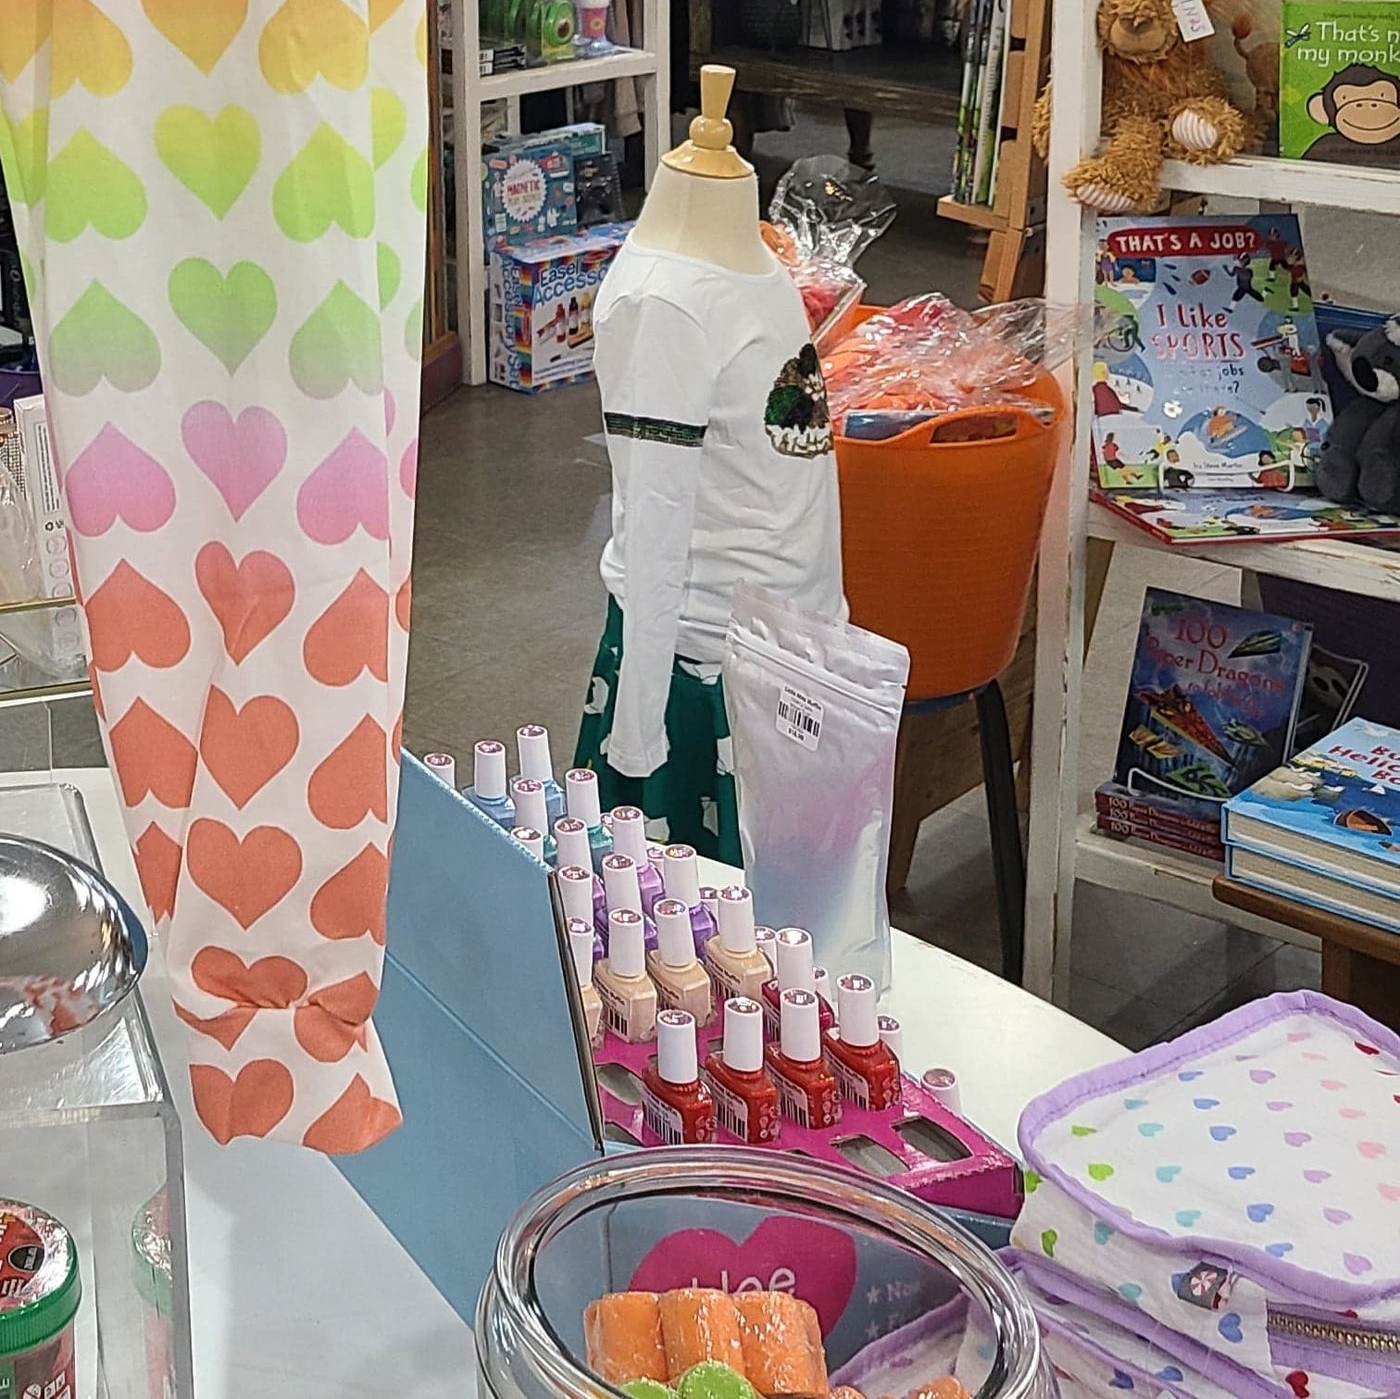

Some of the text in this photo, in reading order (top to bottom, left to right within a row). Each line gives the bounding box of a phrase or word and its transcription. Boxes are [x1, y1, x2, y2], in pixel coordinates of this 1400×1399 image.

[1316, 21, 1380, 42] That's
[1297, 48, 1329, 67] my
[1115, 232, 1255, 252] THAT'S A JOB?
[540, 260, 579, 287] Easel
[1156, 301, 1228, 329] I Like
[1152, 332, 1245, 360] SPORTS
[1175, 618, 1229, 649] 100
